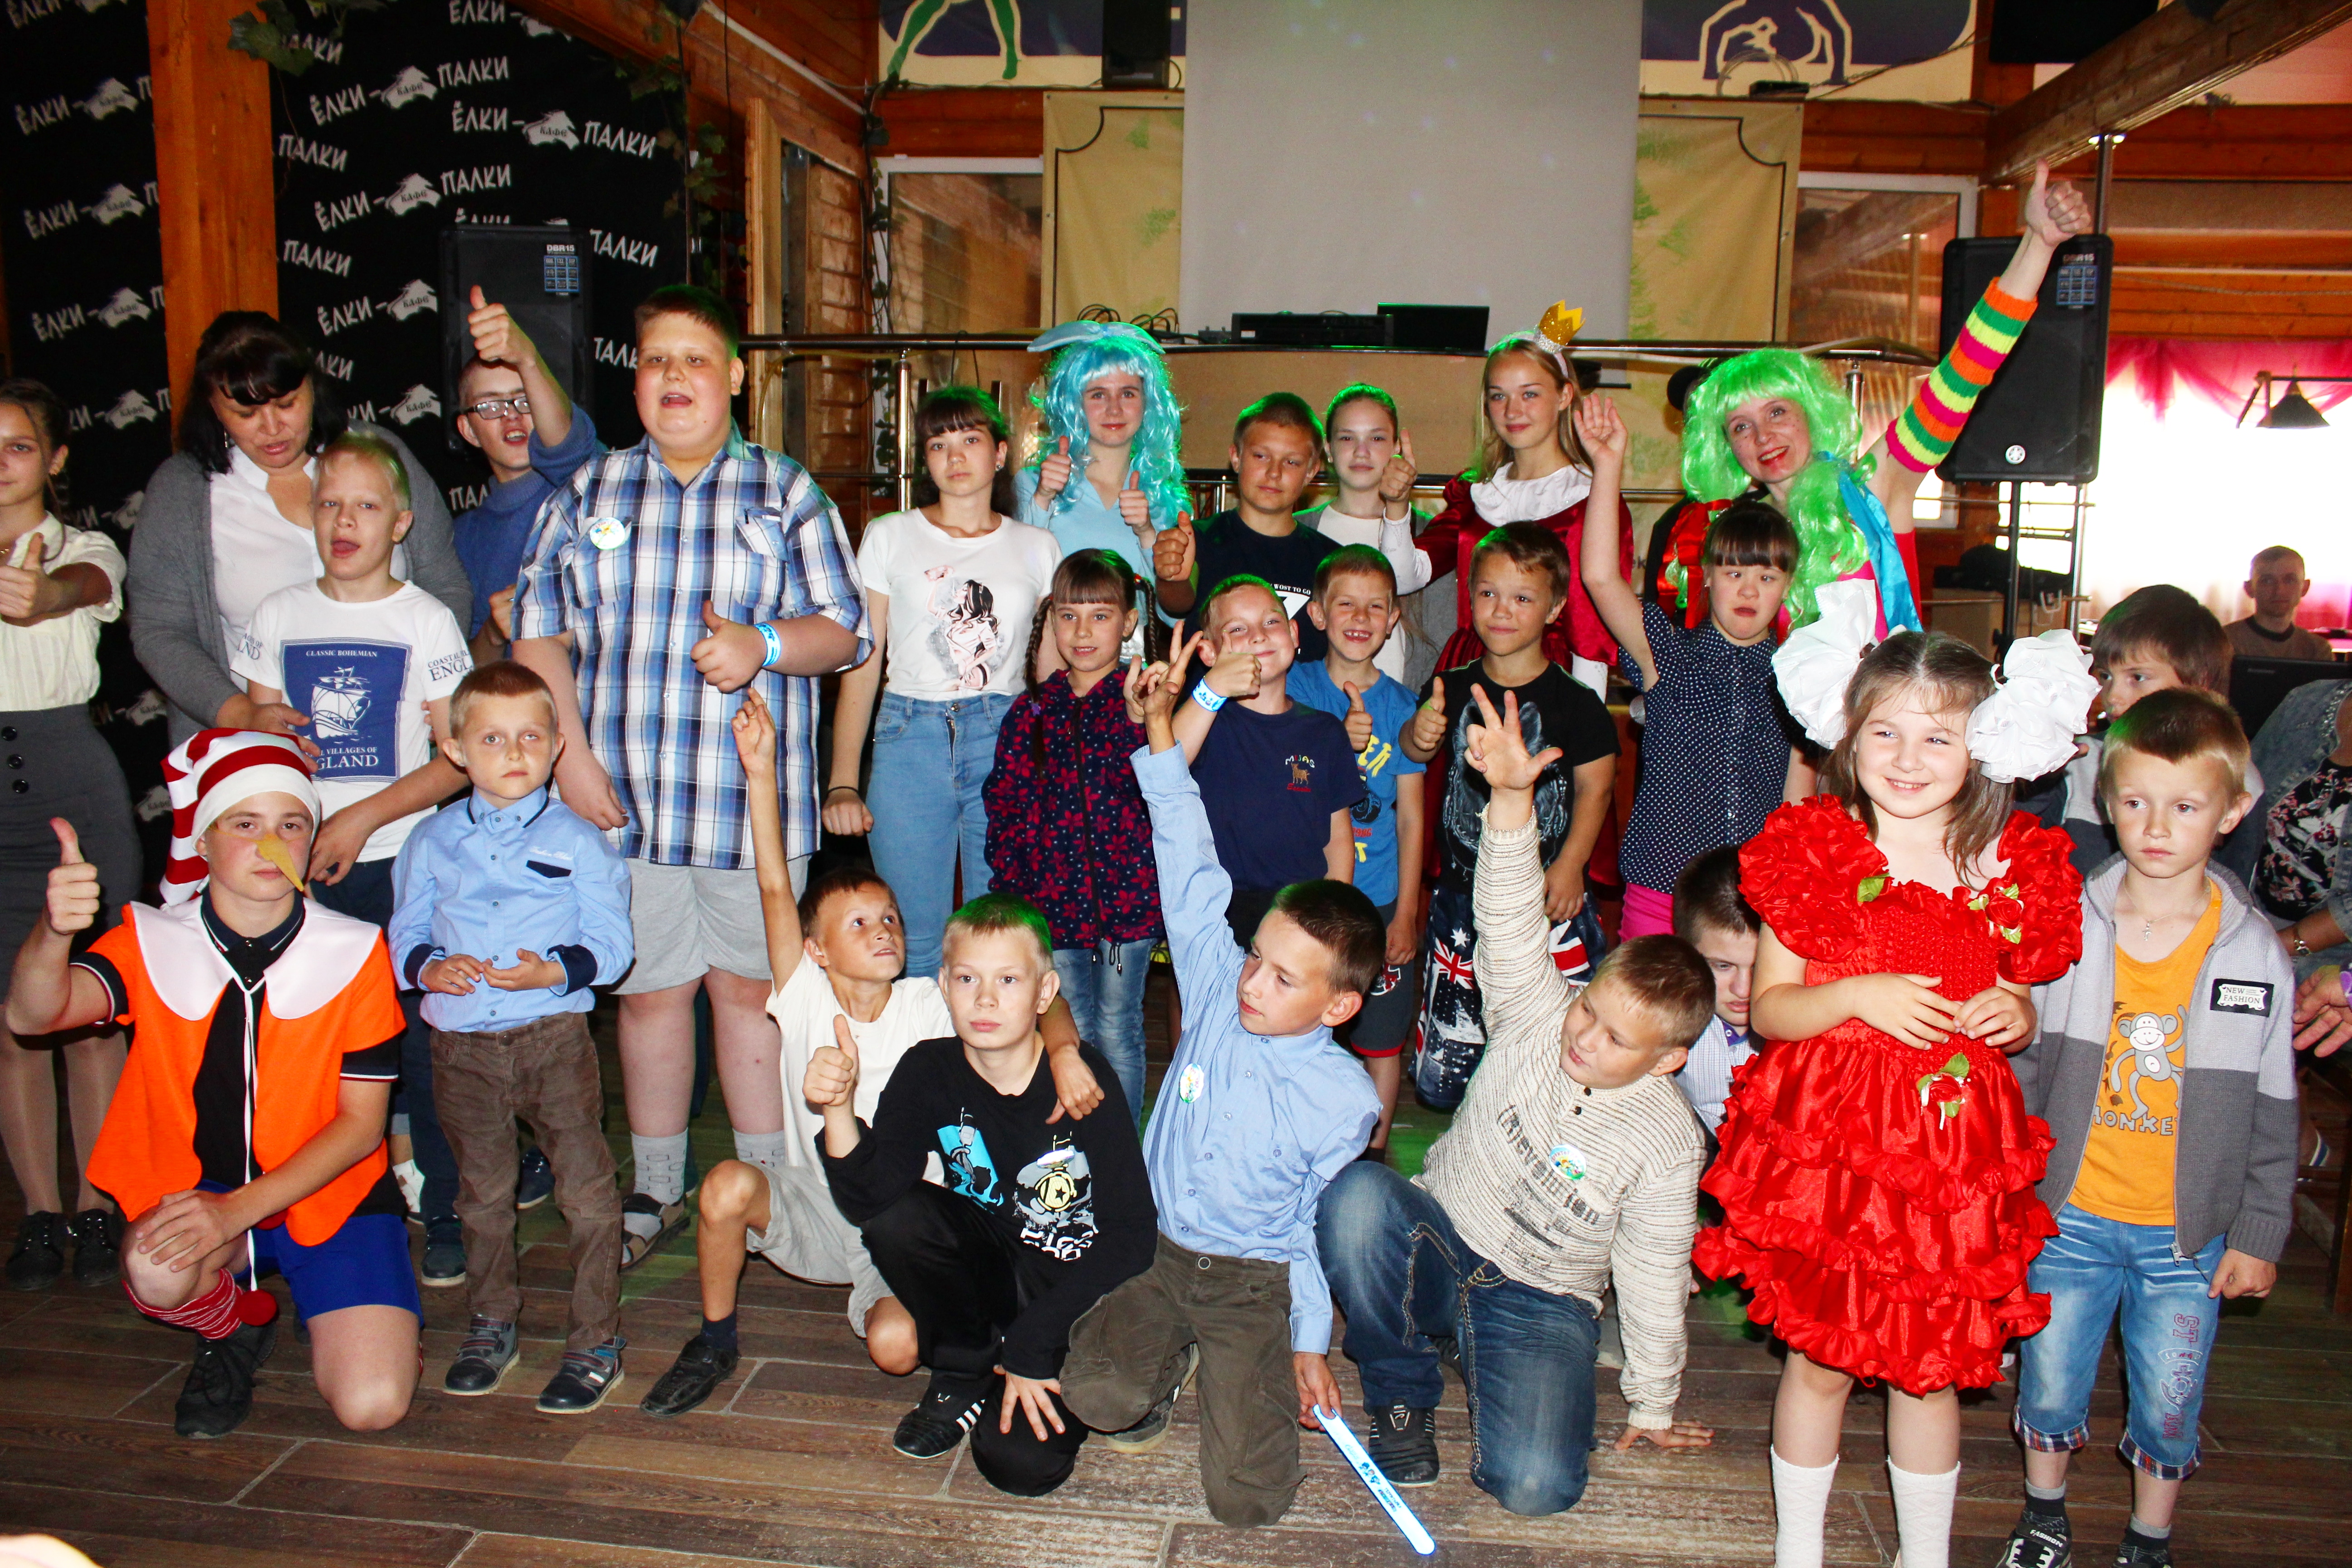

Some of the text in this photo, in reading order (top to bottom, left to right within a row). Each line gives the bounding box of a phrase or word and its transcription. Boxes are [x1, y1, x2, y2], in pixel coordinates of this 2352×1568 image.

[437, 55, 509, 88] ПАЛКИ
[278, 134, 348, 172] ПАЛКИ
[583, 120, 657, 159] ПАЛКИ
[440, 164, 511, 196] ПАЛКИ
[283, 239, 352, 278] ПАЛКИ
[428, 658, 472, 681] ENGL
[316, 755, 379, 770] GLAND
[1285, 755, 1315, 768] MIJAS
[2224, 995, 2260, 1004] FASHION
[2029, 1529, 2063, 1548] FASHION
